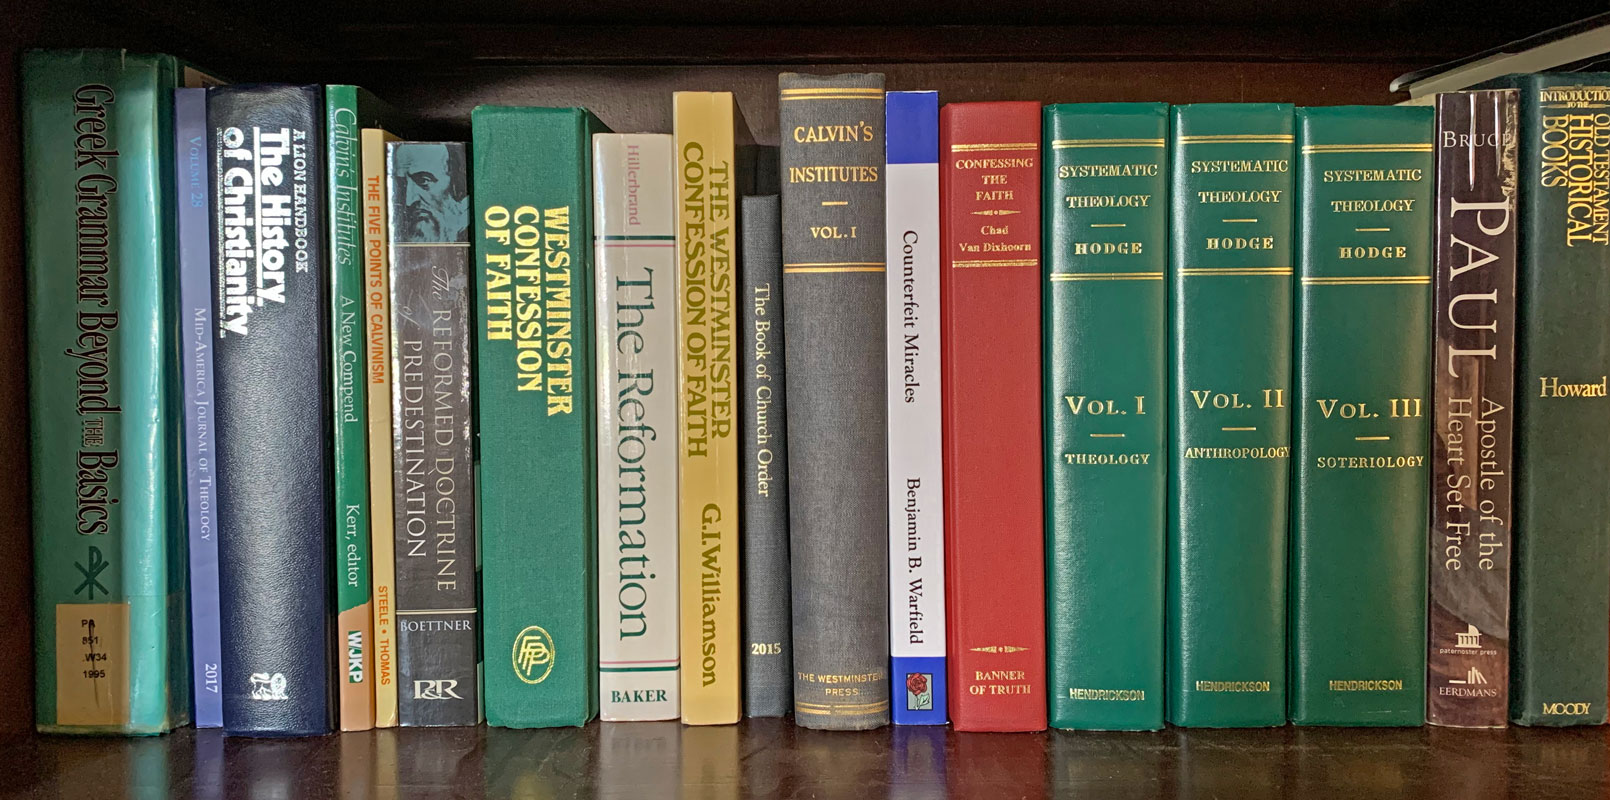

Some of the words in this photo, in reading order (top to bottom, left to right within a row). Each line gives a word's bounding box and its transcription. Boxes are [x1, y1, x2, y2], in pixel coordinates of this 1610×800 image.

[1540, 90, 1610, 102] INTRODUCTIO
[73, 84, 121, 171] Greek
[222, 127, 252, 161] of
[293, 129, 306, 141] A
[334, 107, 358, 178] Calvin's
[793, 120, 873, 143] CALVIN'S
[1594, 113, 1610, 147] OLD
[260, 128, 290, 187] The
[293, 142, 306, 182] LION
[955, 158, 1034, 169] CONFESSING
[1191, 159, 1288, 174] SYSTEMATIC
[1541, 114, 1569, 188] BOOKS
[627, 145, 641, 225] Hillerbrand
[790, 166, 878, 183] INSTITUTES
[981, 175, 1008, 184] THE
[1058, 164, 1158, 178] SYSTEMATIC
[1323, 168, 1422, 183] SYSTEMATIC
[1567, 113, 1594, 247] HISTORICAL
[191, 193, 204, 207] 28
[367, 176, 380, 201] THE
[709, 161, 729, 221] THE
[975, 190, 1014, 200] FAITH
[1066, 195, 1151, 208] THEOLOGY
[1198, 190, 1282, 204] THEOLOGY
[1331, 199, 1416, 212] THEOLOGY
[1592, 149, 1610, 246] TESTAMENT
[293, 184, 309, 273] HANDBOOK
[336, 184, 358, 266] Institutes
[368, 205, 381, 234] FIVE
[484, 206, 511, 245] OF
[683, 142, 706, 327] CONFESSION
[810, 227, 848, 239] VOL.
[850, 227, 857, 239] I
[980, 225, 1009, 235] Chad
[74, 173, 119, 307] Grammar
[222, 167, 254, 336] Christianity
[260, 194, 292, 303] History
[959, 242, 980, 252] Van
[983, 242, 1032, 252] Dixhoorn
[1074, 242, 1143, 255] HODGE
[1206, 237, 1274, 250] HODGE
[1339, 246, 1407, 259] HODGE
[369, 240, 382, 288] POINTS
[903, 230, 919, 328] Counterfeit
[432, 265, 449, 300] The
[486, 254, 513, 341] FAITH
[514, 206, 542, 391] CONFESSION
[754, 283, 770, 316] The
[1448, 196, 1510, 378] PAUL
[340, 296, 355, 308] A
[369, 291, 383, 309] OF
[544, 206, 573, 416] WESTMINSTER
[616, 266, 655, 355] The
[340, 312, 356, 347] New
[709, 226, 731, 439] WESTMINSTER
[755, 320, 771, 359] Book
[64, 310, 123, 416] Beyond
[370, 314, 384, 384] CALVINISM
[686, 333, 707, 370] OF
[432, 310, 455, 447] REFORMED
[756, 363, 771, 380] of
[904, 334, 920, 403] Miracles
[340, 350, 358, 423] Compend
[1262, 389, 1285, 408] II
[1540, 376, 1608, 398] Howard
[687, 375, 708, 457] FAITH
[756, 386, 772, 445] Church
[1135, 395, 1146, 415] I
[1389, 398, 1423, 418] III
[83, 417, 106, 446] THE
[403, 340, 427, 557] PREDESTINATION
[1447, 397, 1472, 466] Heart
[1475, 396, 1505, 490] Apostle
[1065, 453, 1150, 465] THEOLOGY
[1184, 447, 1291, 459] ANTHROPOLOGY
[1317, 456, 1424, 468] SOTERIOLOGY
[757, 449, 773, 497] Order
[76, 449, 120, 535] Basics
[617, 369, 657, 641] Reformation
[1446, 474, 1471, 513] Set
[345, 504, 360, 539] Kerr,
[434, 457, 457, 591] DOCTRINE
[905, 478, 921, 551] Benjamin
[1479, 499, 1503, 525] of
[1445, 521, 1470, 571] Free
[1479, 533, 1503, 570] the
[346, 542, 361, 588] editor
[908, 556, 921, 573] B.
[378, 585, 389, 626] STEELE
[908, 578, 924, 644] Warfield
[82, 636, 99, 645] 851
[400, 620, 472, 632] BOETTNER
[348, 631, 362, 682] WJKP
[379, 638, 391, 685] THOMAS
[751, 643, 781, 655] 2015
[83, 670, 106, 678] 1995
[205, 663, 218, 693] 2017
[798, 672, 815, 682] THE
[969, 685, 986, 695] OF
[989, 684, 1031, 694] TRUTH
[975, 670, 1025, 681] BANNER
[1196, 680, 1270, 692] HENDRICKSON
[1329, 679, 1403, 691] HENDRICKSON
[611, 690, 667, 703] BAKER
[825, 688, 859, 696] PRESS
[1069, 688, 1145, 701] HENDRICKSON
[1439, 686, 1497, 697] EERDMANS
[1542, 703, 1591, 715] MOODY
